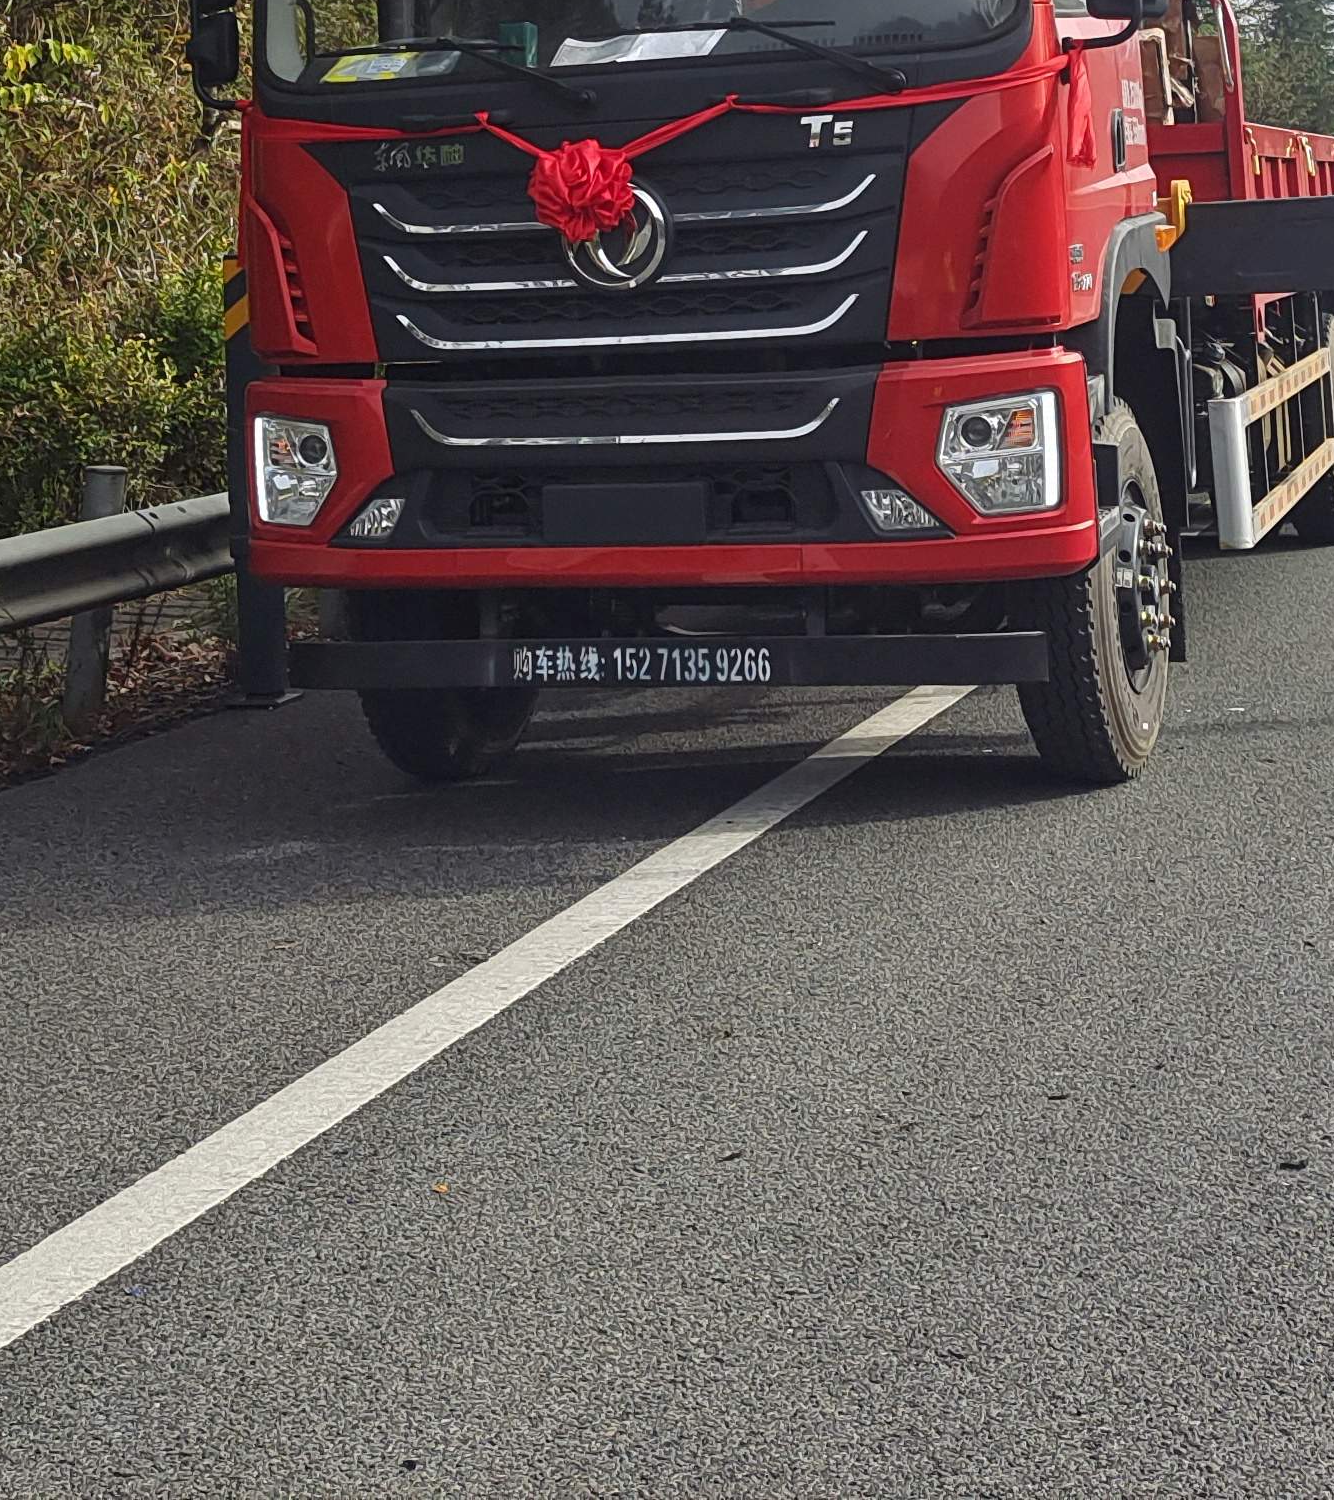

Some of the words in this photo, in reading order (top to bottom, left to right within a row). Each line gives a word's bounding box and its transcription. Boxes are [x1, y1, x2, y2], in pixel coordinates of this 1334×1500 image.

[800, 114, 855, 148] T5
[513, 645, 606, 682] 购车热线:
